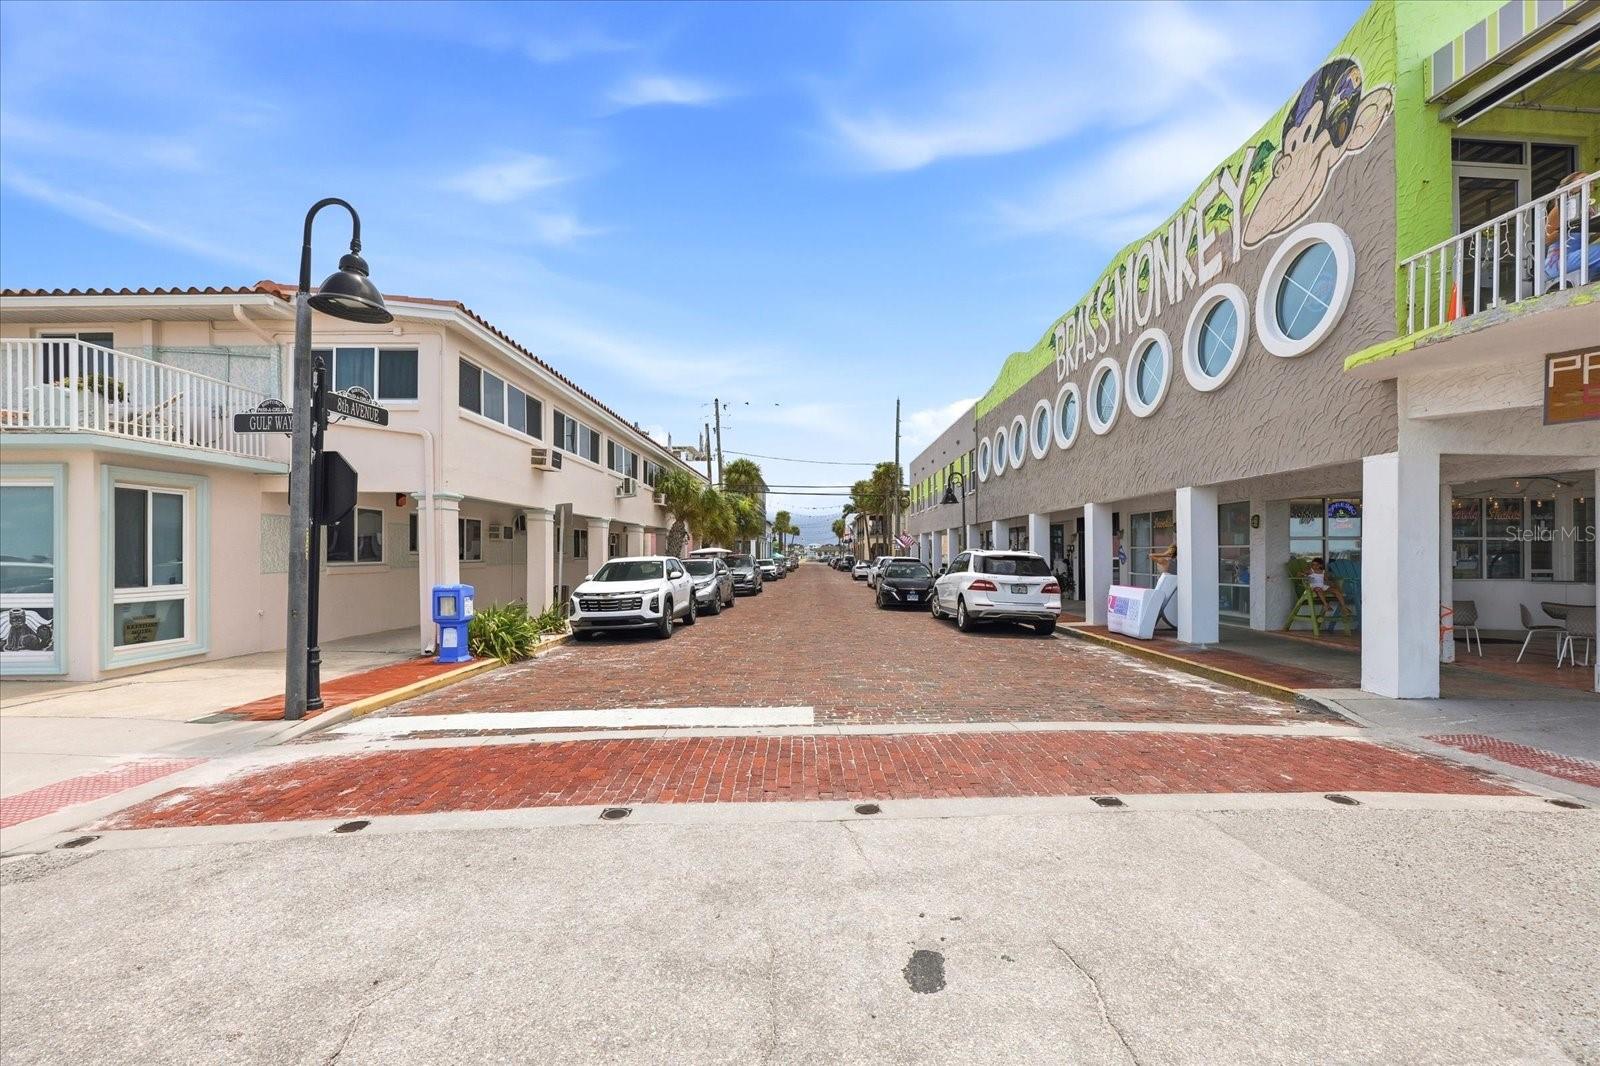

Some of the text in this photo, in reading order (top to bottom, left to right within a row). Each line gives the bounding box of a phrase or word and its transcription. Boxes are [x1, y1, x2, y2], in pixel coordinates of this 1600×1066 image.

[337, 398, 379, 421] 8th AVENUE
[249, 415, 293, 430] GULF WAY
